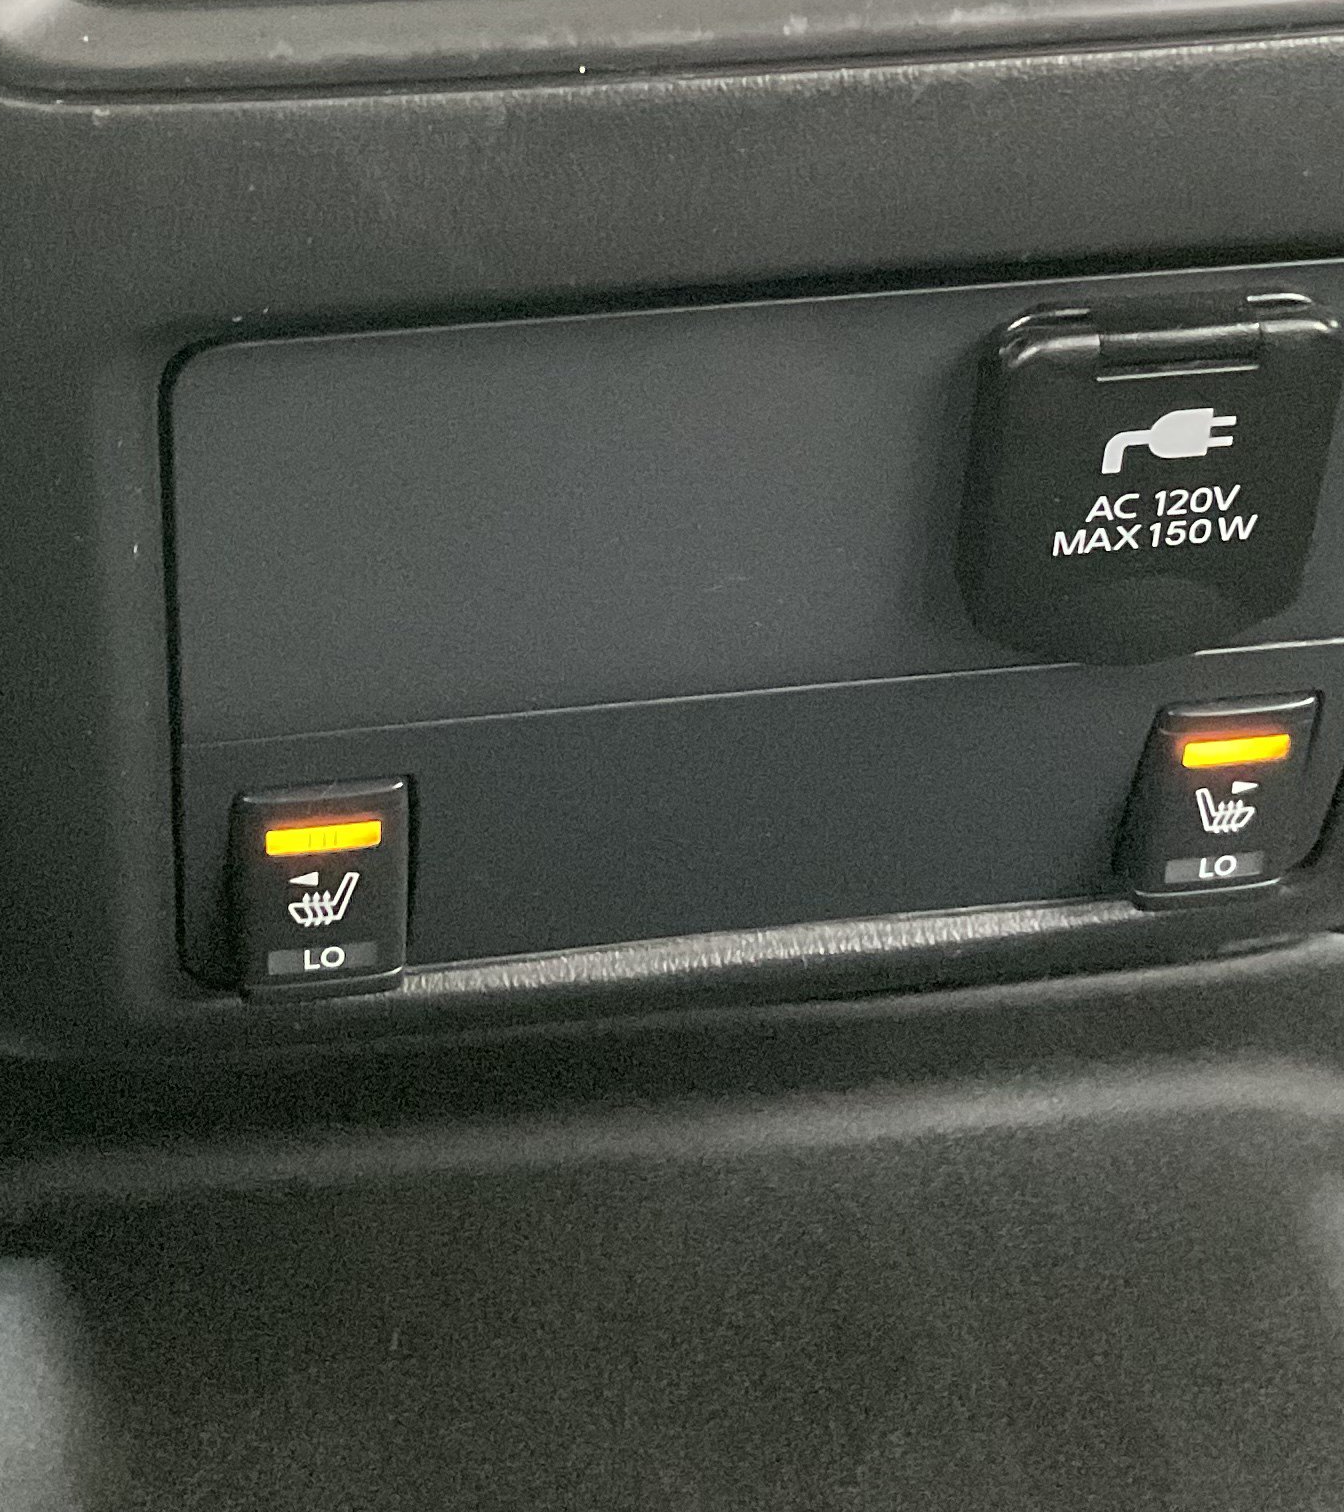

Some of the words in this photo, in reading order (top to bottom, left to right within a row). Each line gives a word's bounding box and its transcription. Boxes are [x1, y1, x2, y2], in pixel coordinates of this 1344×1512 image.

[1085, 492, 1140, 523] AC
[1155, 484, 1241, 516] 120V
[1052, 523, 1141, 557] MAX
[1150, 513, 1258, 548] 150W
[1198, 854, 1237, 879] LO
[304, 946, 346, 970] LO
